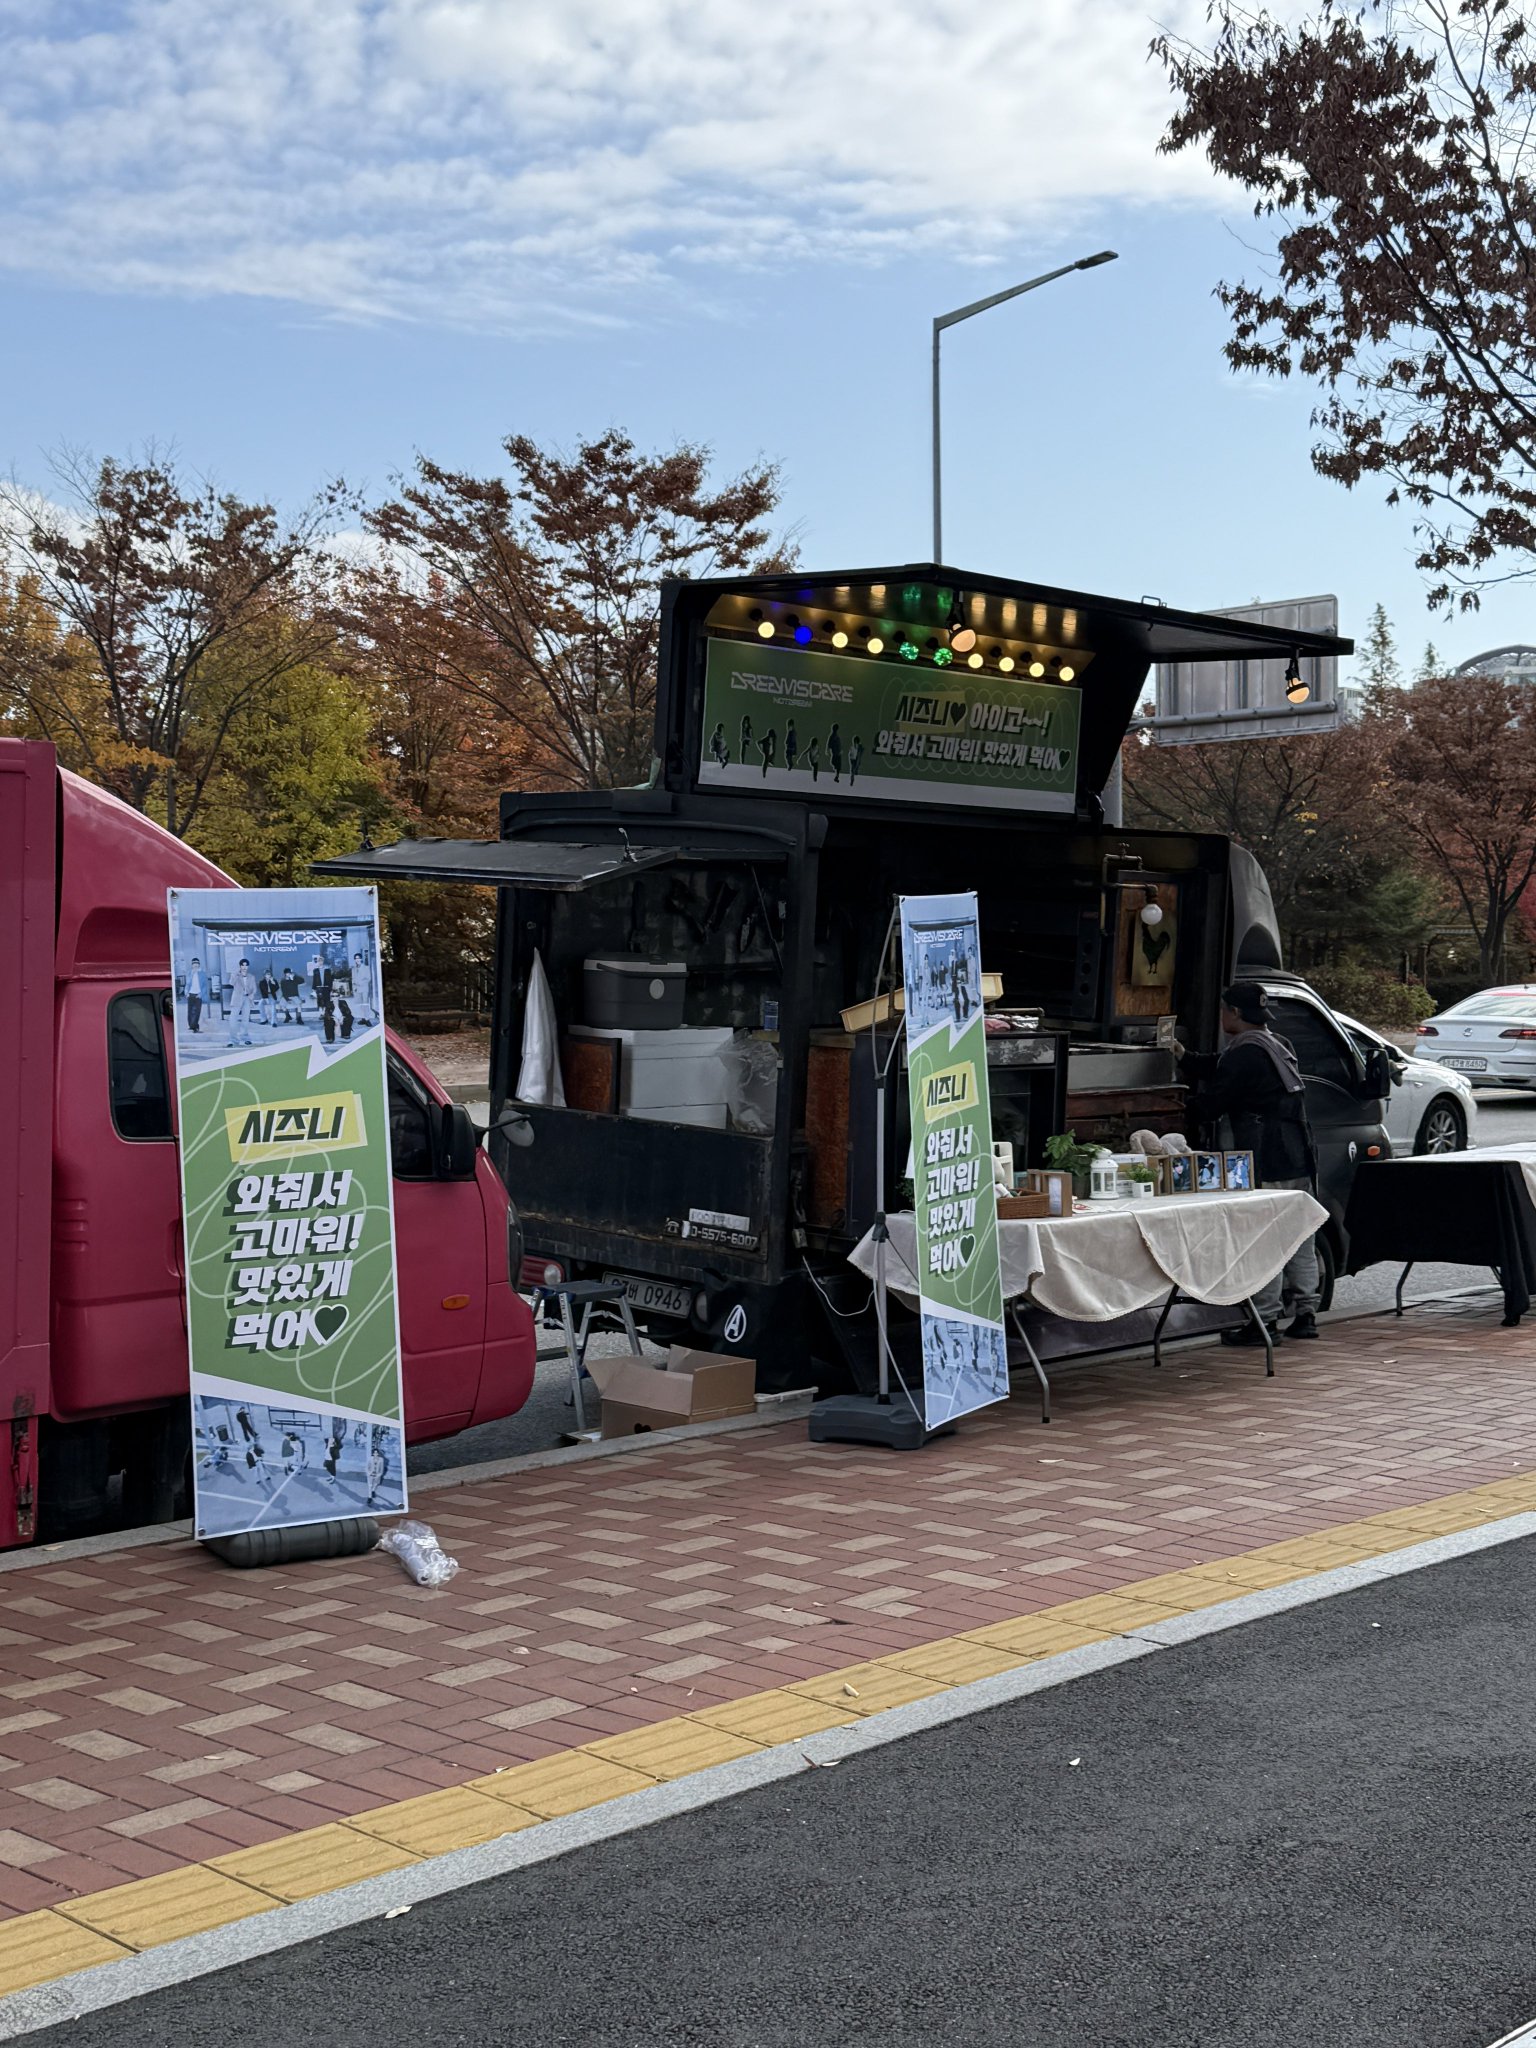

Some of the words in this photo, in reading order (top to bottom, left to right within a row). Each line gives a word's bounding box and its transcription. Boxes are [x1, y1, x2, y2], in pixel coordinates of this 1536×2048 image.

[895, 695, 950, 726] 시즈니
[875, 729, 925, 757] 와줘서
[926, 735, 981, 763] 고마워!
[982, 741, 1028, 767] 맛있게
[1029, 745, 1061, 771] 먹어
[926, 1072, 967, 1108] 시즈니
[238, 1106, 345, 1144] 시즈니
[927, 1124, 973, 1165] 와줘서
[233, 1169, 353, 1213] 와줘서
[927, 1160, 980, 1202] 고마워!
[229, 1214, 364, 1260] 고마워!
[928, 1197, 976, 1240] 맛있게
[929, 1237, 961, 1275] 먹어
[232, 1259, 354, 1306] 맛있게
[644, 1285, 683, 1311] 0946
[231, 1309, 314, 1350] 먹어
